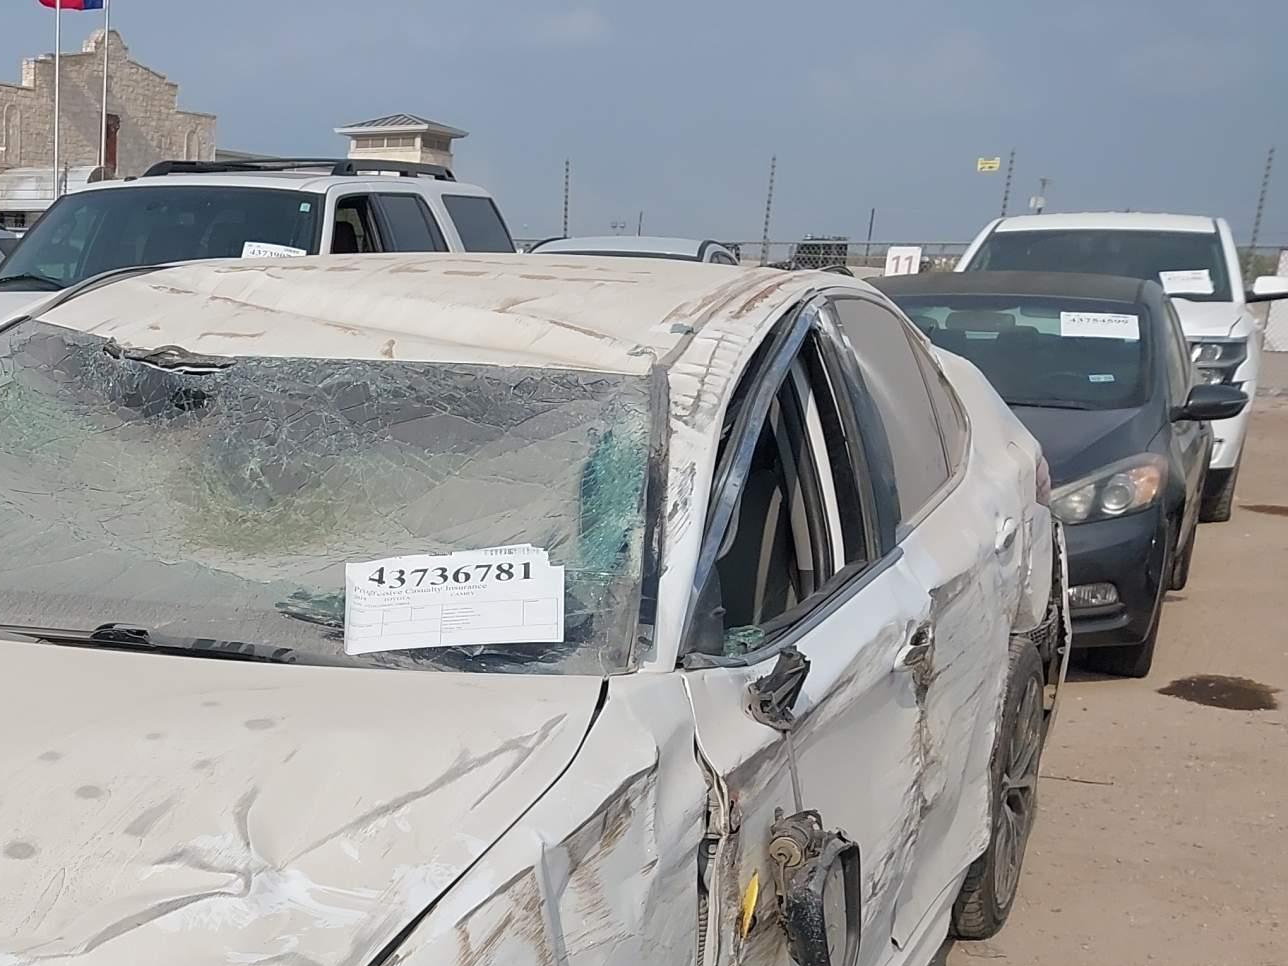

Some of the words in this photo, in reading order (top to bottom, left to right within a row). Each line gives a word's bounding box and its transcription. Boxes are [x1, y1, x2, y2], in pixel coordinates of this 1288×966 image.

[892, 255, 913, 274] 11
[367, 561, 536, 589] 43736781
[354, 585, 402, 597] Progressive
[404, 585, 441, 594] Casualty
[445, 583, 488, 592] Insurance
